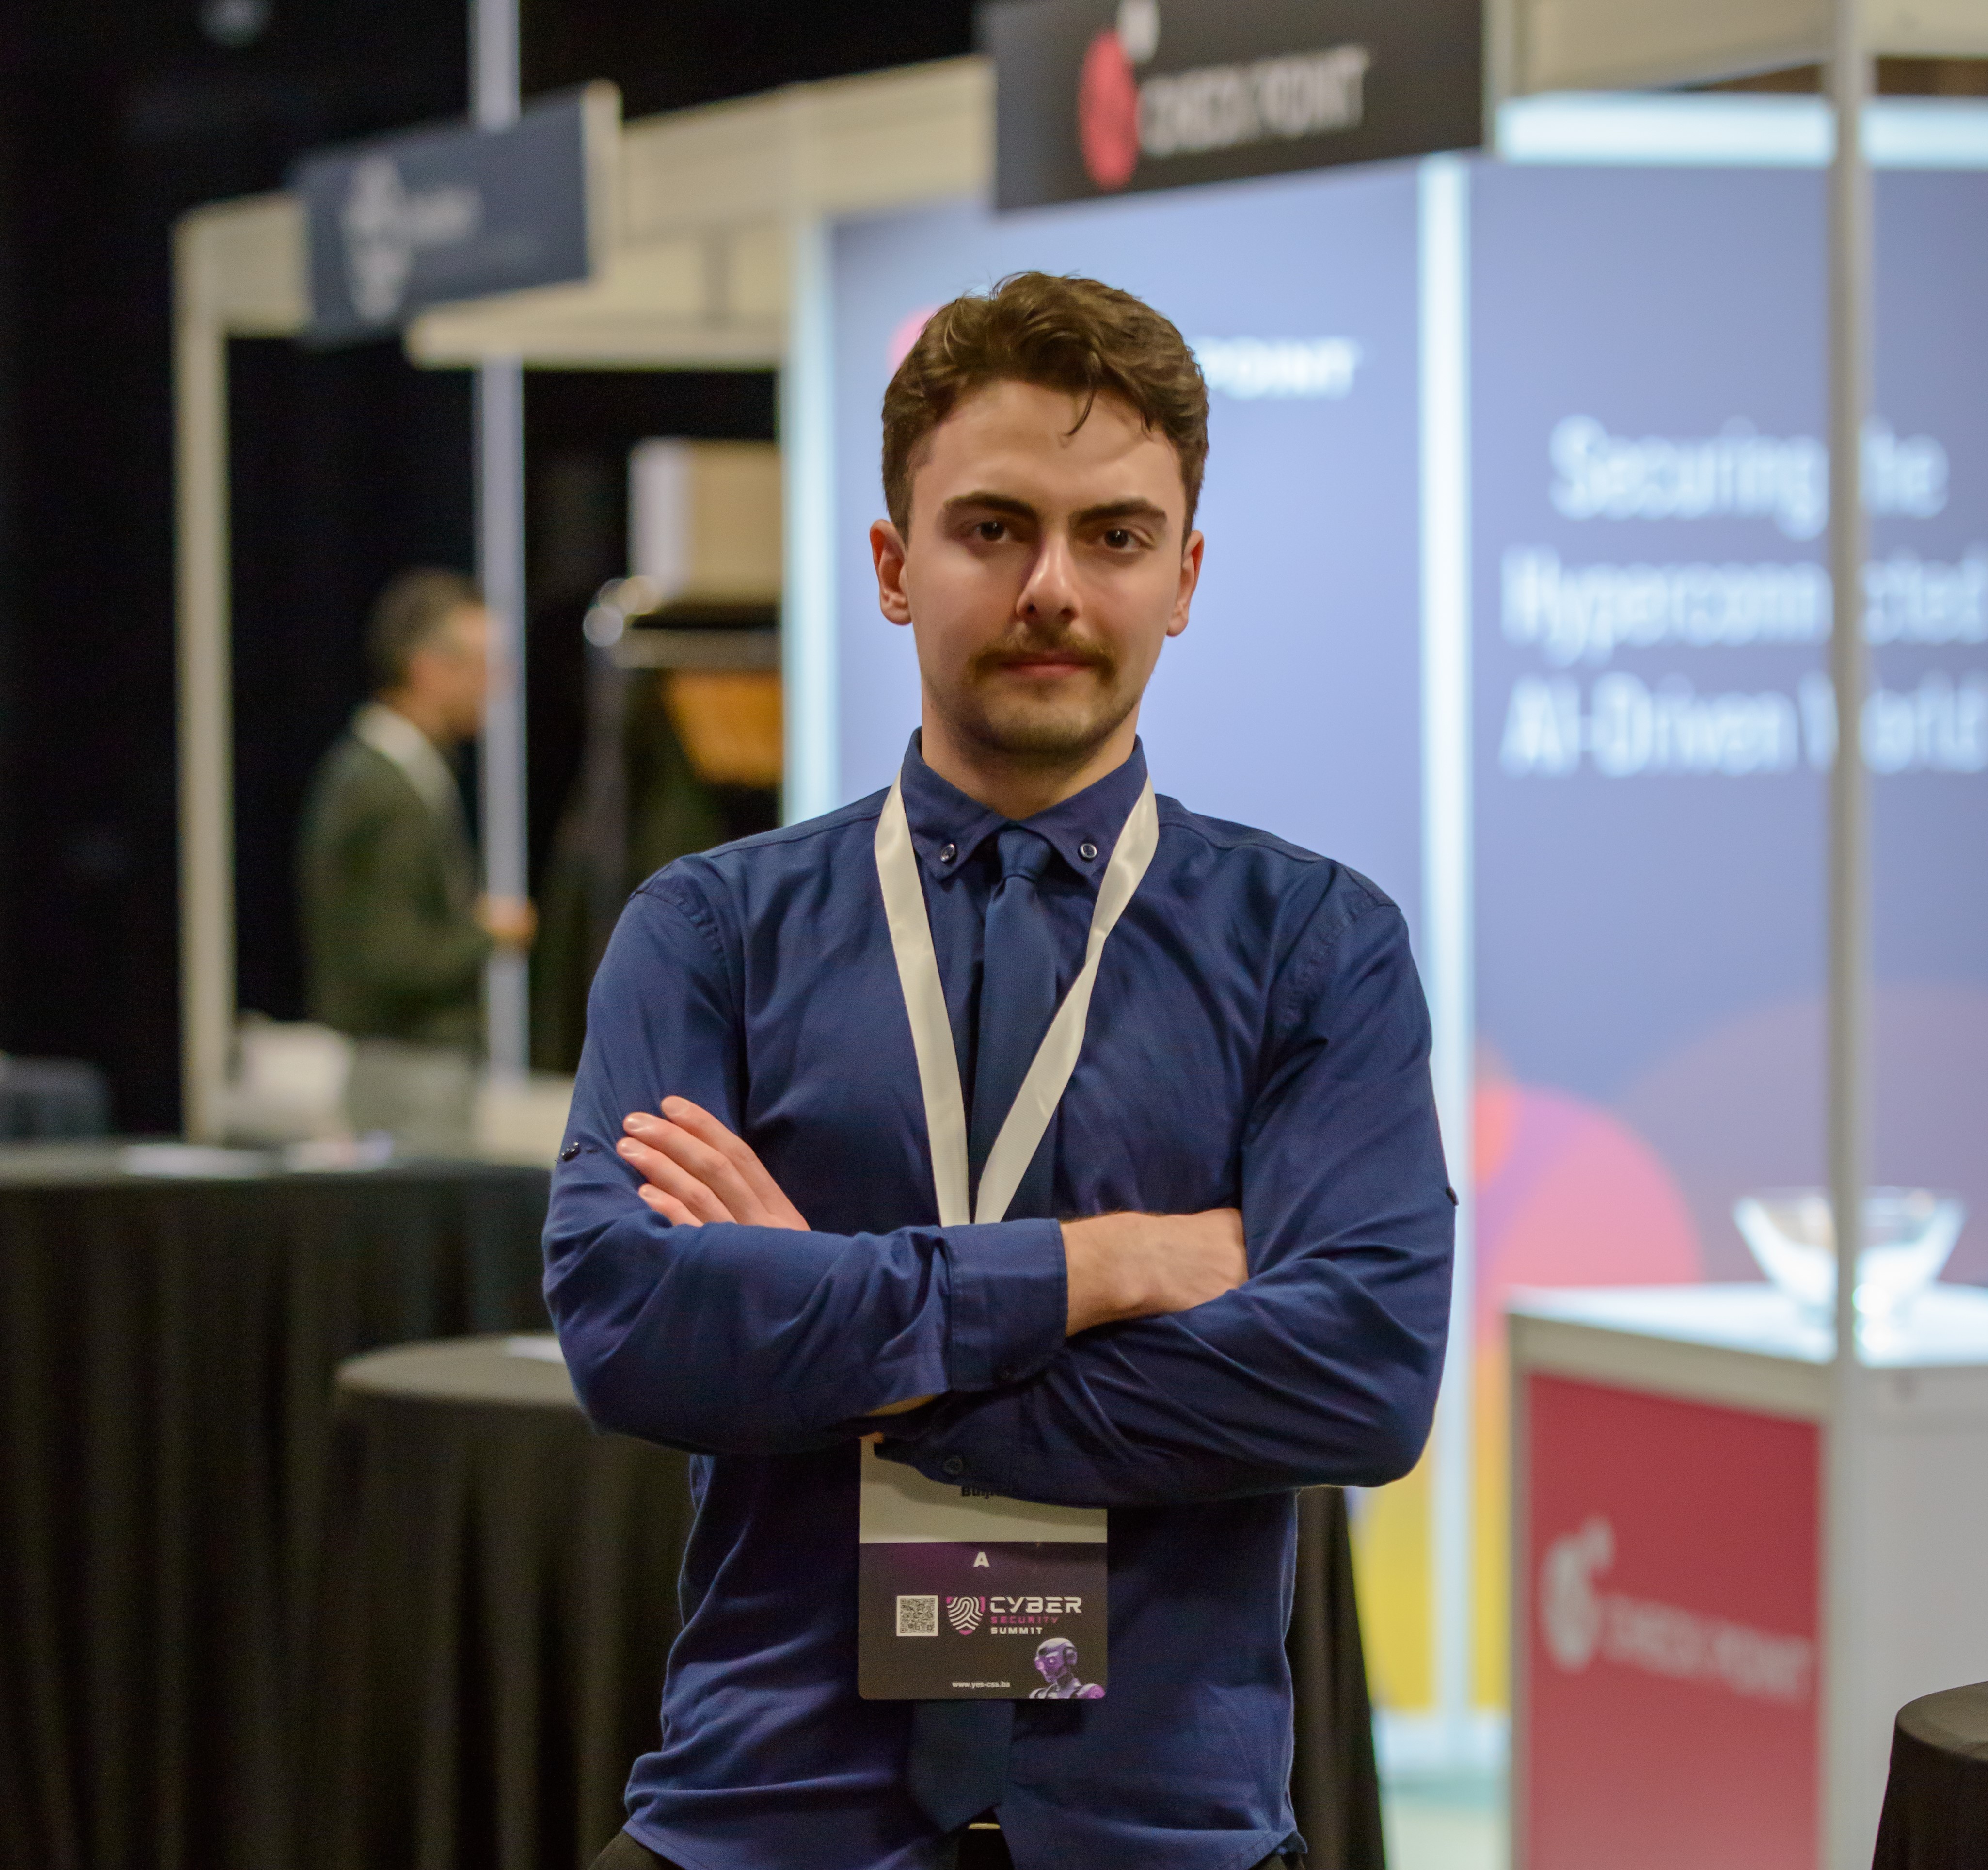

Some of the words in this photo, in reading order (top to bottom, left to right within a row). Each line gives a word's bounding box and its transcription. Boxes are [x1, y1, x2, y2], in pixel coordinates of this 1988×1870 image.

[1551, 415, 1829, 539] Securing
[1858, 416, 1948, 518] he
[1499, 673, 1798, 777] AI-Driven
[973, 1552, 990, 1567] A
[990, 1596, 1082, 1613] CYBER
